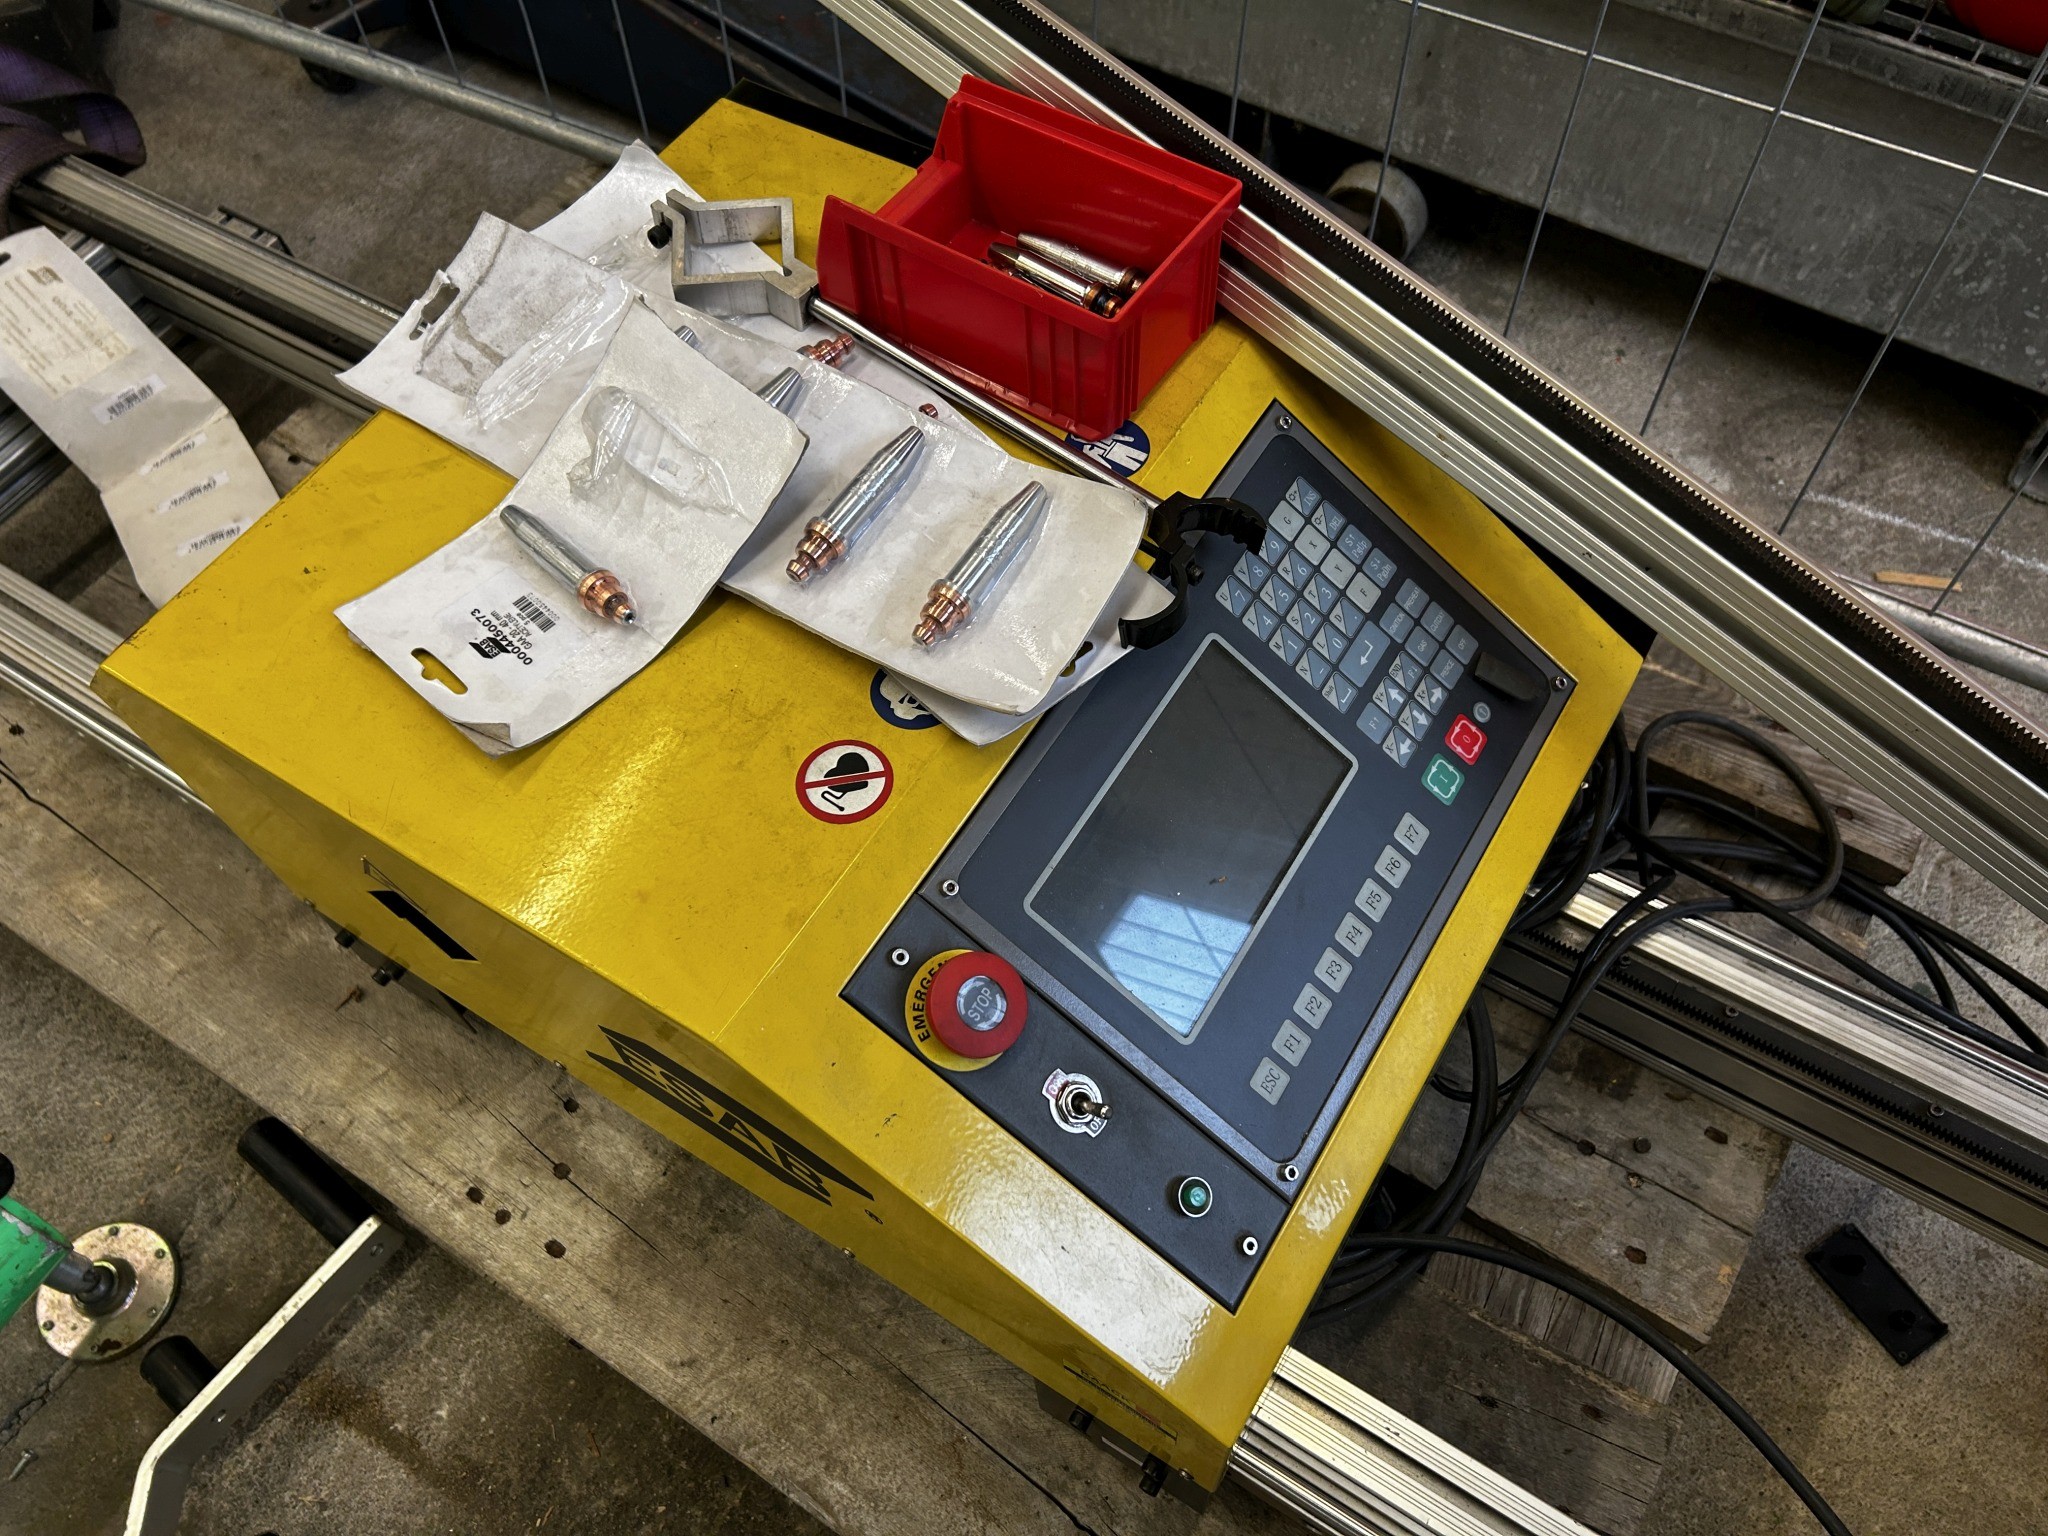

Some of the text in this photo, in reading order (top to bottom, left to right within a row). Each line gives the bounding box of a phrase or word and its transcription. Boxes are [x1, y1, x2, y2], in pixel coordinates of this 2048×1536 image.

[1304, 490, 1316, 506] INS
[1284, 516, 1291, 524] G
[1330, 516, 1342, 530] DEL
[1270, 541, 1280, 552] 9
[1309, 541, 1317, 549] X
[1352, 540, 1368, 558] PgUp
[1252, 566, 1264, 576] 8
[1282, 566, 1290, 575] R
[1298, 564, 1307, 576] 6
[1334, 564, 1342, 572] Y
[1377, 564, 1392, 582] PgDn
[1220, 592, 1228, 601] U
[1234, 590, 1245, 602] 7
[1265, 591, 1273, 600] J
[1278, 590, 1289, 602] 5
[1308, 590, 1316, 598] T
[1322, 588, 1332, 599] 3
[1360, 588, 1368, 597] F
[1404, 586, 1420, 610] PREHEAT
[491, 610, 502, 621] mm
[1263, 616, 1272, 626] 4
[1291, 616, 1300, 626] S
[1304, 612, 1316, 624] 2
[1334, 614, 1342, 622] D
[500, 620, 509, 628] 40
[504, 612, 532, 637] ACETYLENE
[1389, 613, 1405, 634] IGNITION
[471, 608, 532, 665] 0004450073
[509, 630, 520, 638] 20
[480, 638, 500, 658] ESAB
[517, 636, 532, 650] GAA
[1273, 642, 1282, 651] M
[1288, 640, 1298, 650] 1
[1317, 642, 1326, 650] L
[1332, 638, 1342, 648] 0
[1418, 640, 1428, 652] GAS
[1458, 638, 1466, 650] OFF
[1300, 666, 1308, 675] N
[1390, 664, 1401, 677] END
[1440, 659, 1454, 678] PIERCE
[1375, 691, 1384, 702] Y+
[1417, 689, 1426, 700] X+
[1401, 716, 1410, 726] Y-
[1385, 742, 1394, 753] X-
[1404, 824, 1418, 844] F7
[1385, 857, 1401, 876] F6
[1366, 890, 1382, 910] F5
[1346, 925, 1362, 946] F4
[1326, 960, 1342, 980] F3
[968, 987, 993, 1022] STOP
[1305, 996, 1322, 1017] F2
[1284, 1034, 1301, 1054] F1
[1261, 1068, 1280, 1095] ESC
[606, 1035, 831, 1197] ESAB
[1089, 1117, 1102, 1130] OF
